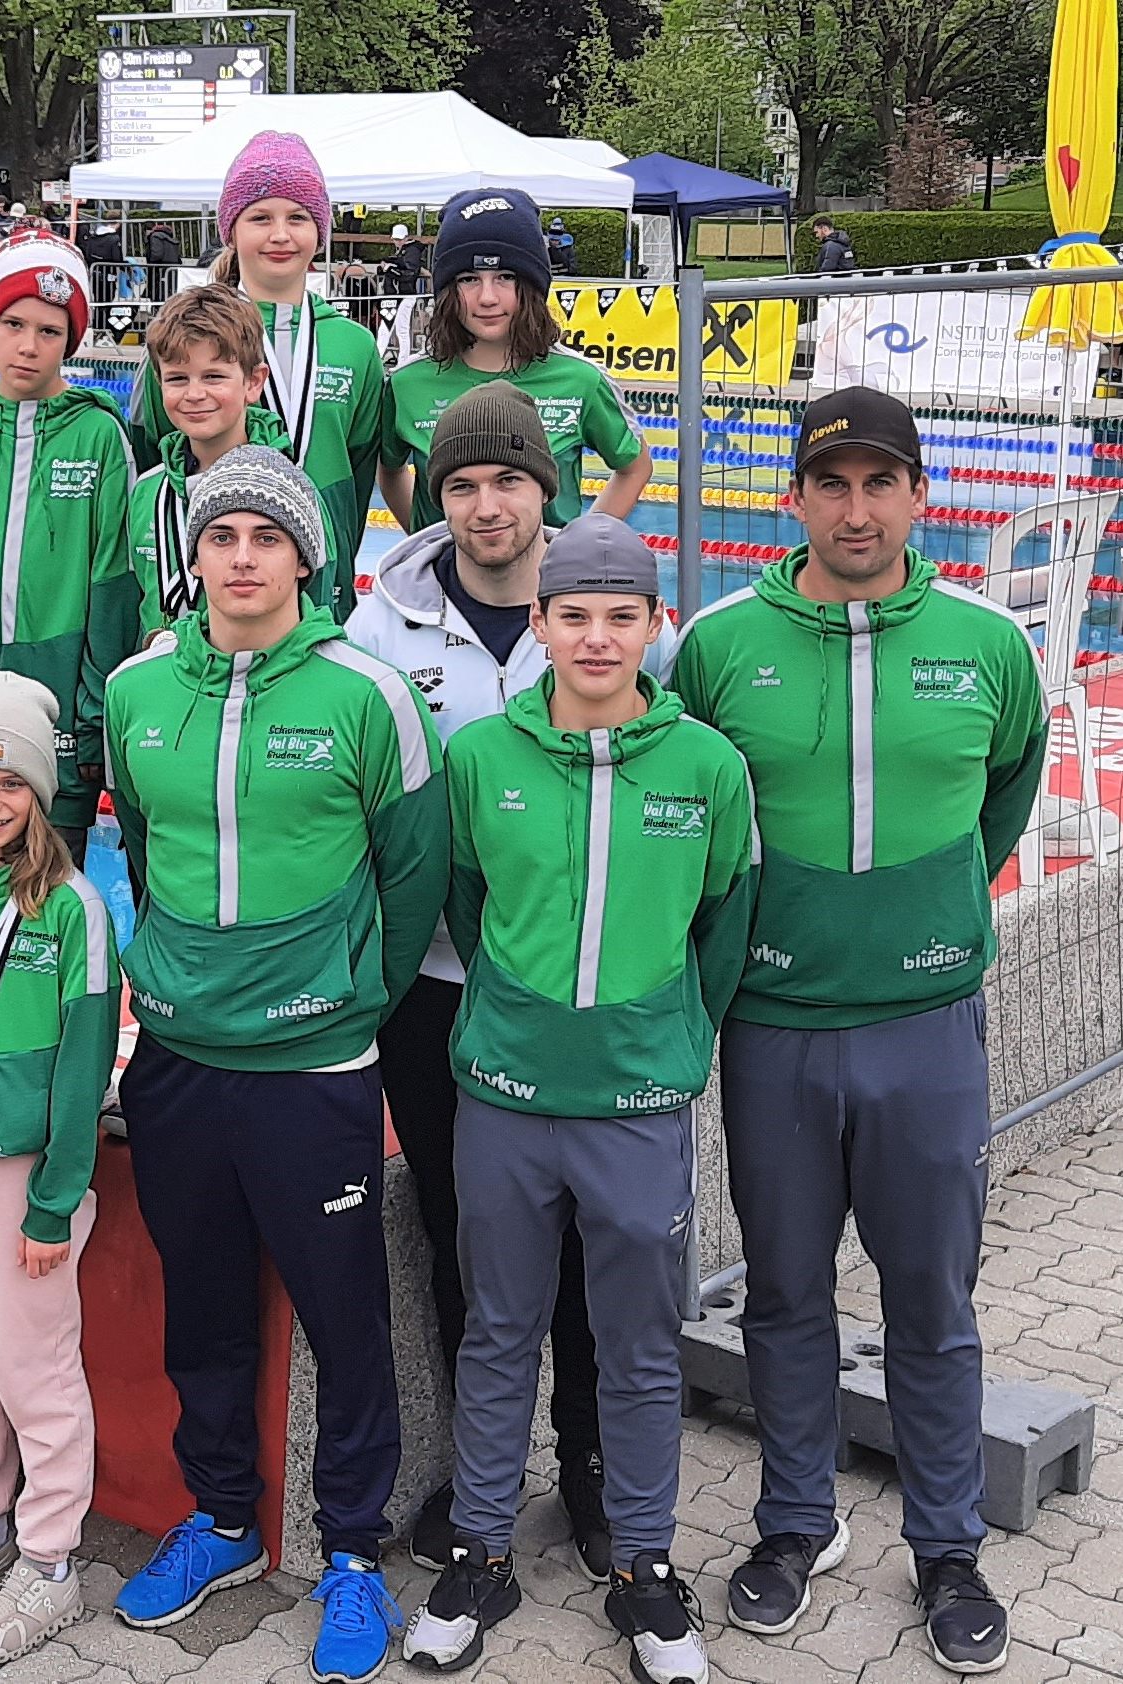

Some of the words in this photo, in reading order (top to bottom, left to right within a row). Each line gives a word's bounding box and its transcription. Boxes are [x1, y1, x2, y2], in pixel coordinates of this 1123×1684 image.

[559, 329, 677, 372] ffeisen
[409, 666, 444, 680] arena
[912, 668, 933, 681] Val
[934, 668, 955, 682] Blu
[267, 736, 287, 750] Val
[287, 736, 308, 751] Blu
[643, 803, 664, 818] Val
[665, 804, 685, 819] Blu
[18, 938, 37, 954] Blu
[903, 947, 973, 970] bludenz
[138, 991, 175, 1018] vkw
[266, 999, 345, 1020] bludenz
[483, 1071, 537, 1101] vkw
[616, 1091, 693, 1110] bludenz
[323, 1191, 363, 1215] PUMA
